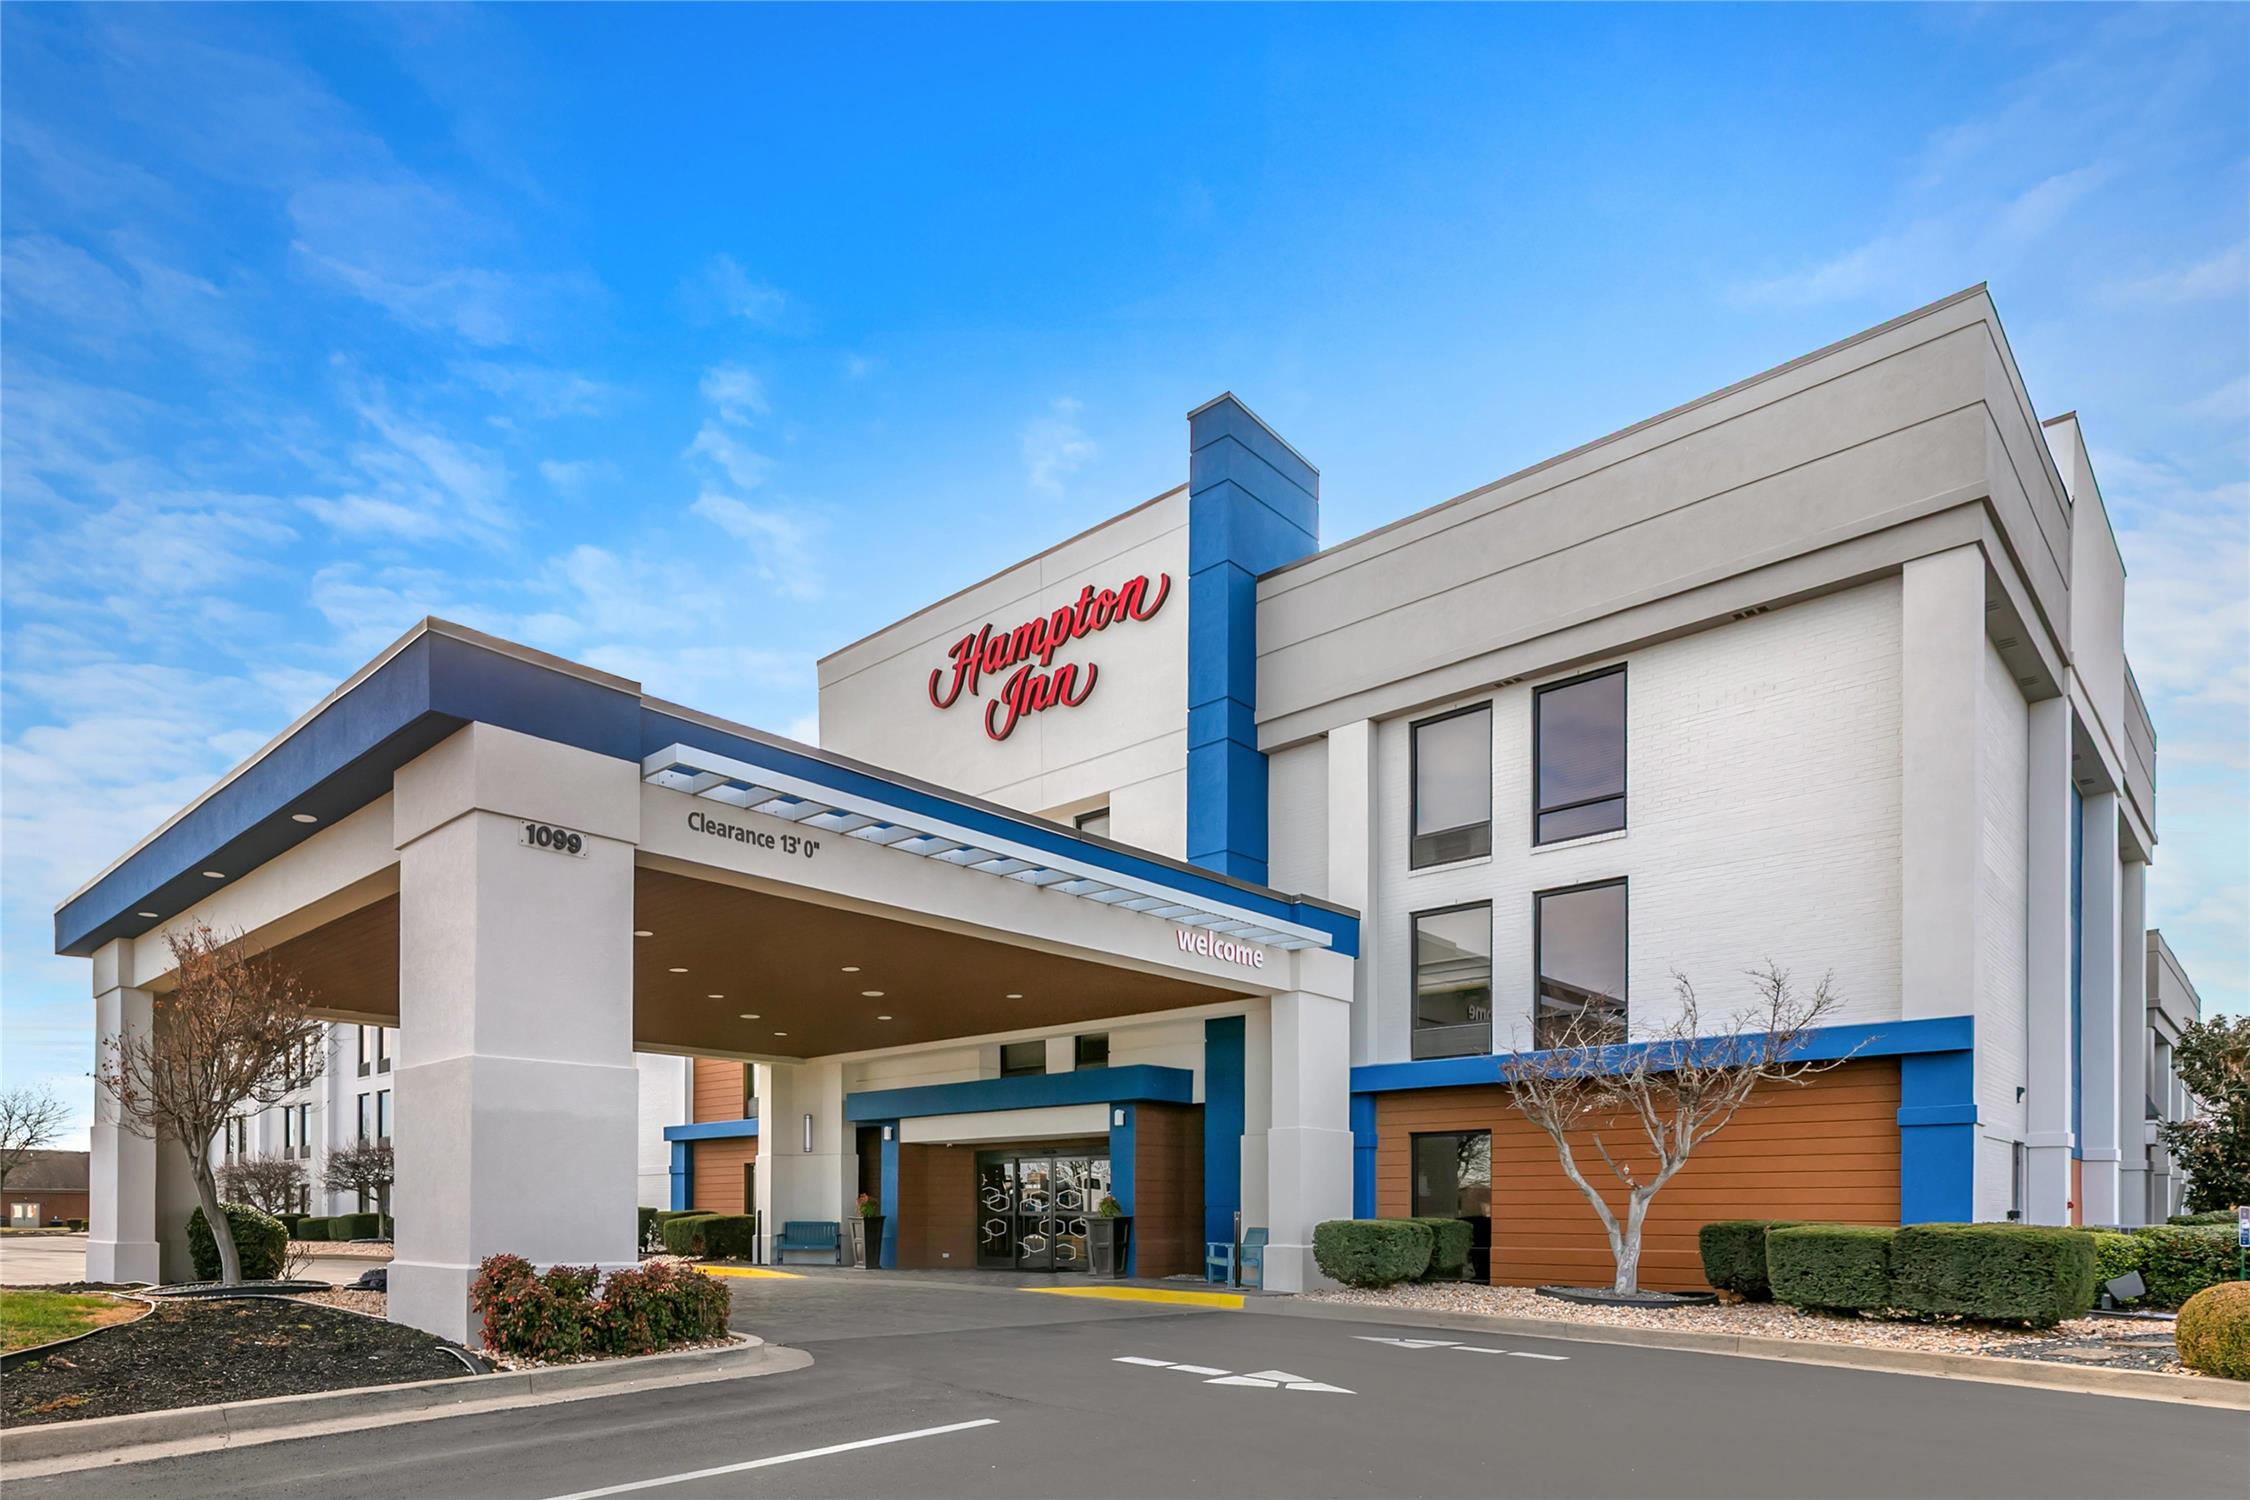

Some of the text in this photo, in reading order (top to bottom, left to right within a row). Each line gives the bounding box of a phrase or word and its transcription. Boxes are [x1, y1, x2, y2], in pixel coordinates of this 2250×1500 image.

[929, 573, 1171, 709] Hampton
[985, 662, 1098, 741] Inn
[526, 823, 582, 854] 1099
[687, 811, 775, 849] Clearance
[780, 834, 801, 854] 13'
[1176, 929, 1264, 969] welcome
